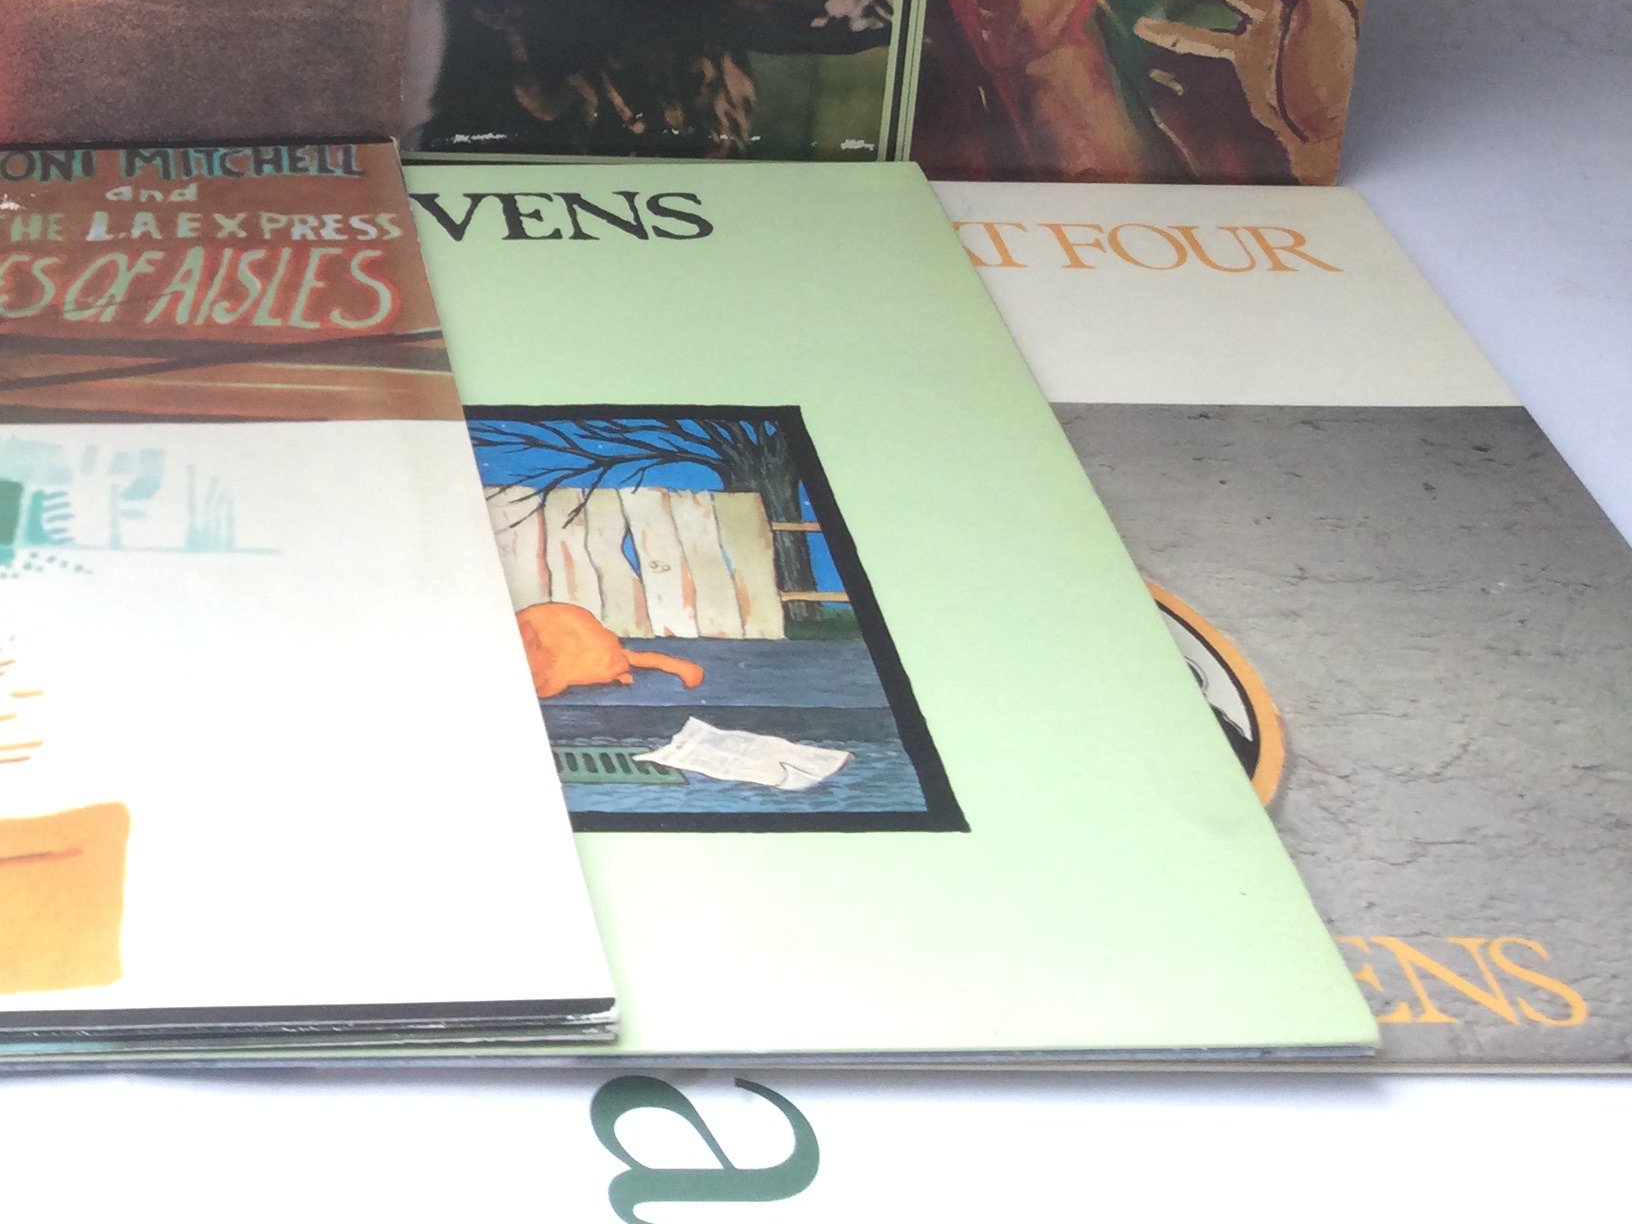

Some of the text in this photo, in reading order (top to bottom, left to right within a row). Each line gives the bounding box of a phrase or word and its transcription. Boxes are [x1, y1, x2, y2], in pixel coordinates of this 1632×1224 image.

[120, 144, 364, 180] MITCHELL
[106, 182, 198, 203] and
[176, 211, 403, 241] EXPRESS
[409, 191, 714, 242] VENS
[1037, 222, 1344, 273] FOUR
[64, 250, 164, 323] OF
[144, 246, 392, 329] AISLES
